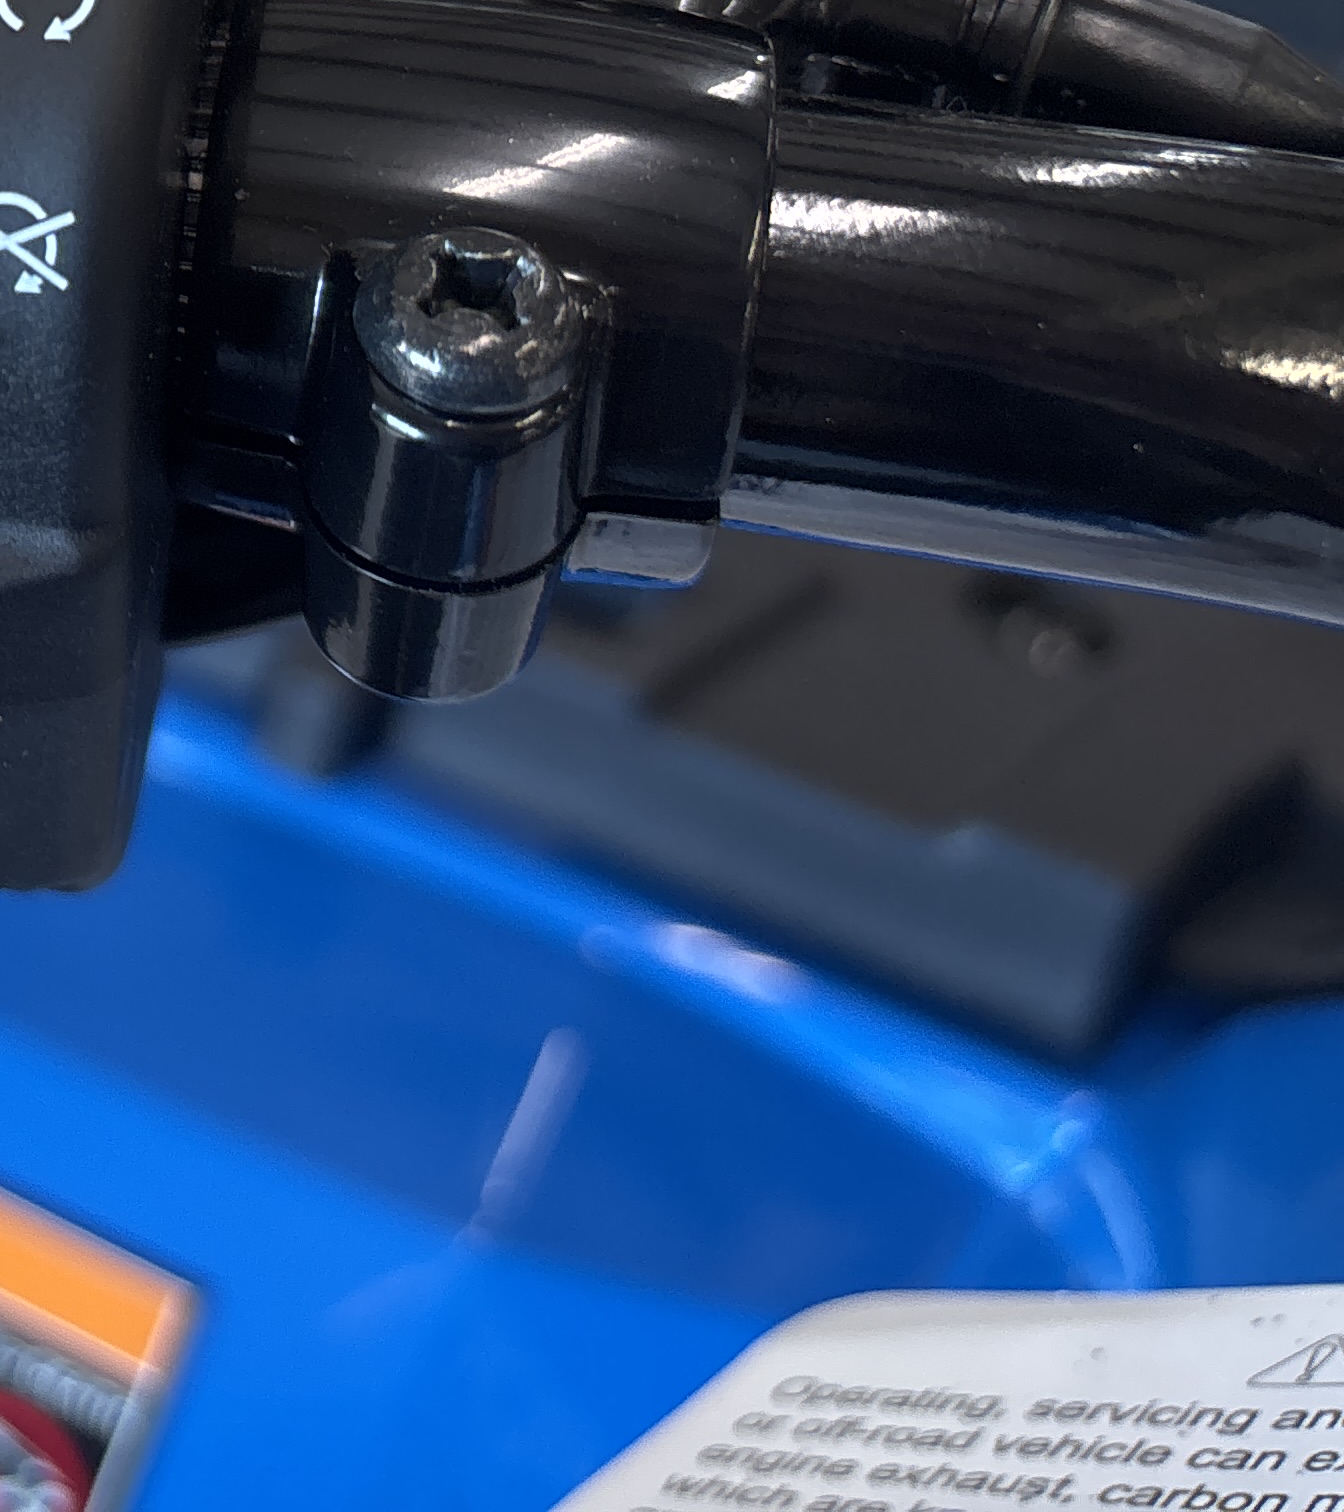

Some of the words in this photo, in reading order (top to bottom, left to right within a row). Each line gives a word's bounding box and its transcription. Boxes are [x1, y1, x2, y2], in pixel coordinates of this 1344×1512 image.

[770, 1376, 1007, 1421] Operating,
[1025, 1398, 1260, 1436] servicing
[1271, 1407, 1344, 1431] an
[732, 1411, 790, 1438] or
[792, 1414, 984, 1451] off-road
[993, 1434, 1173, 1466] vehicle
[1187, 1446, 1287, 1471] can
[662, 1473, 799, 1509] which
[696, 1443, 860, 1478] engine
[866, 1461, 1076, 1505] exhaust,
[1098, 1482, 1289, 1512] carbon
